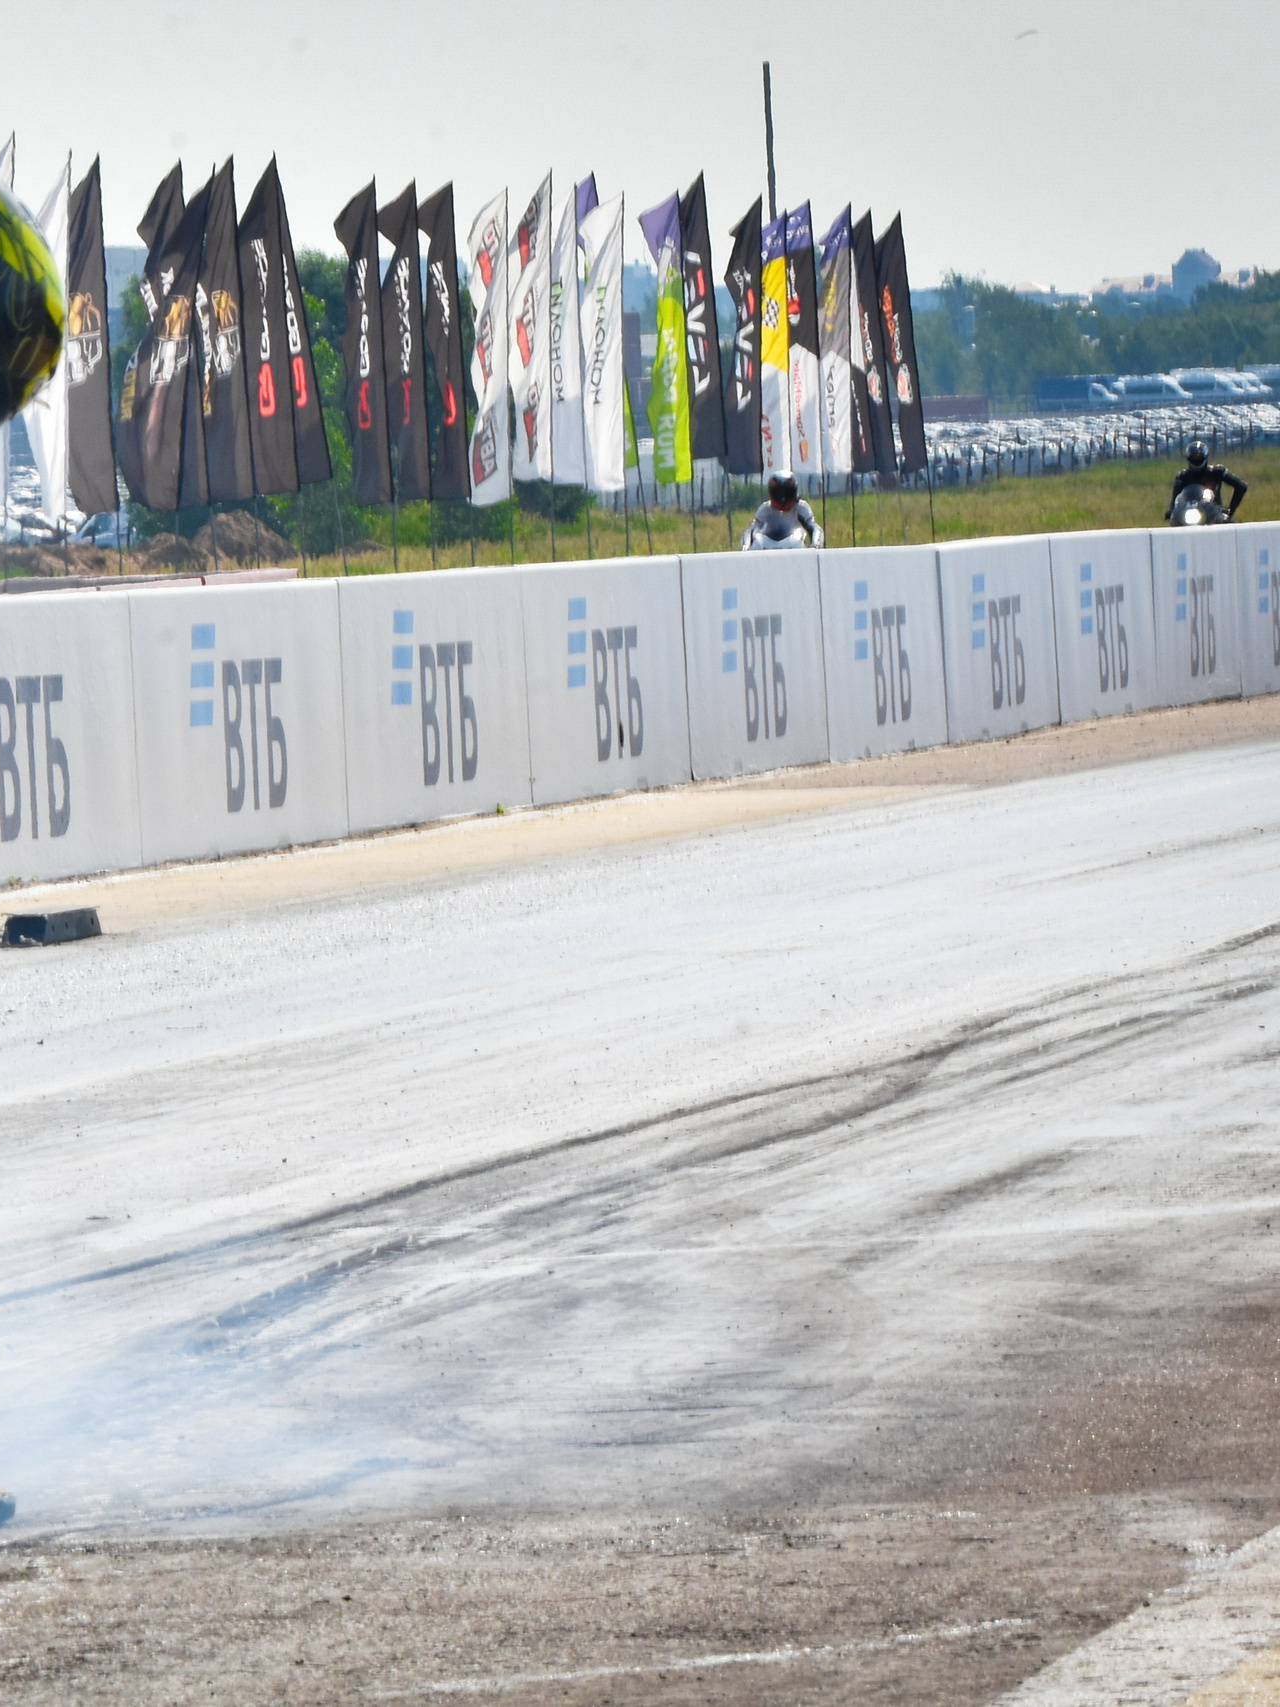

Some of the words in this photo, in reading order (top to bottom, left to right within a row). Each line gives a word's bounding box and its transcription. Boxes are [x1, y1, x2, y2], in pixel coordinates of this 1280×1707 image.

[742, 614, 788, 742] ВТБ
[871, 605, 912, 726] ВТБ
[988, 594, 1026, 710] ВТБ
[1095, 584, 1129, 692] ВТБ
[1190, 574, 1216, 677] ВТБ
[222, 657, 288, 813] ВТБ
[419, 641, 478, 786] ВТБ
[592, 626, 644, 761] ВТБ
